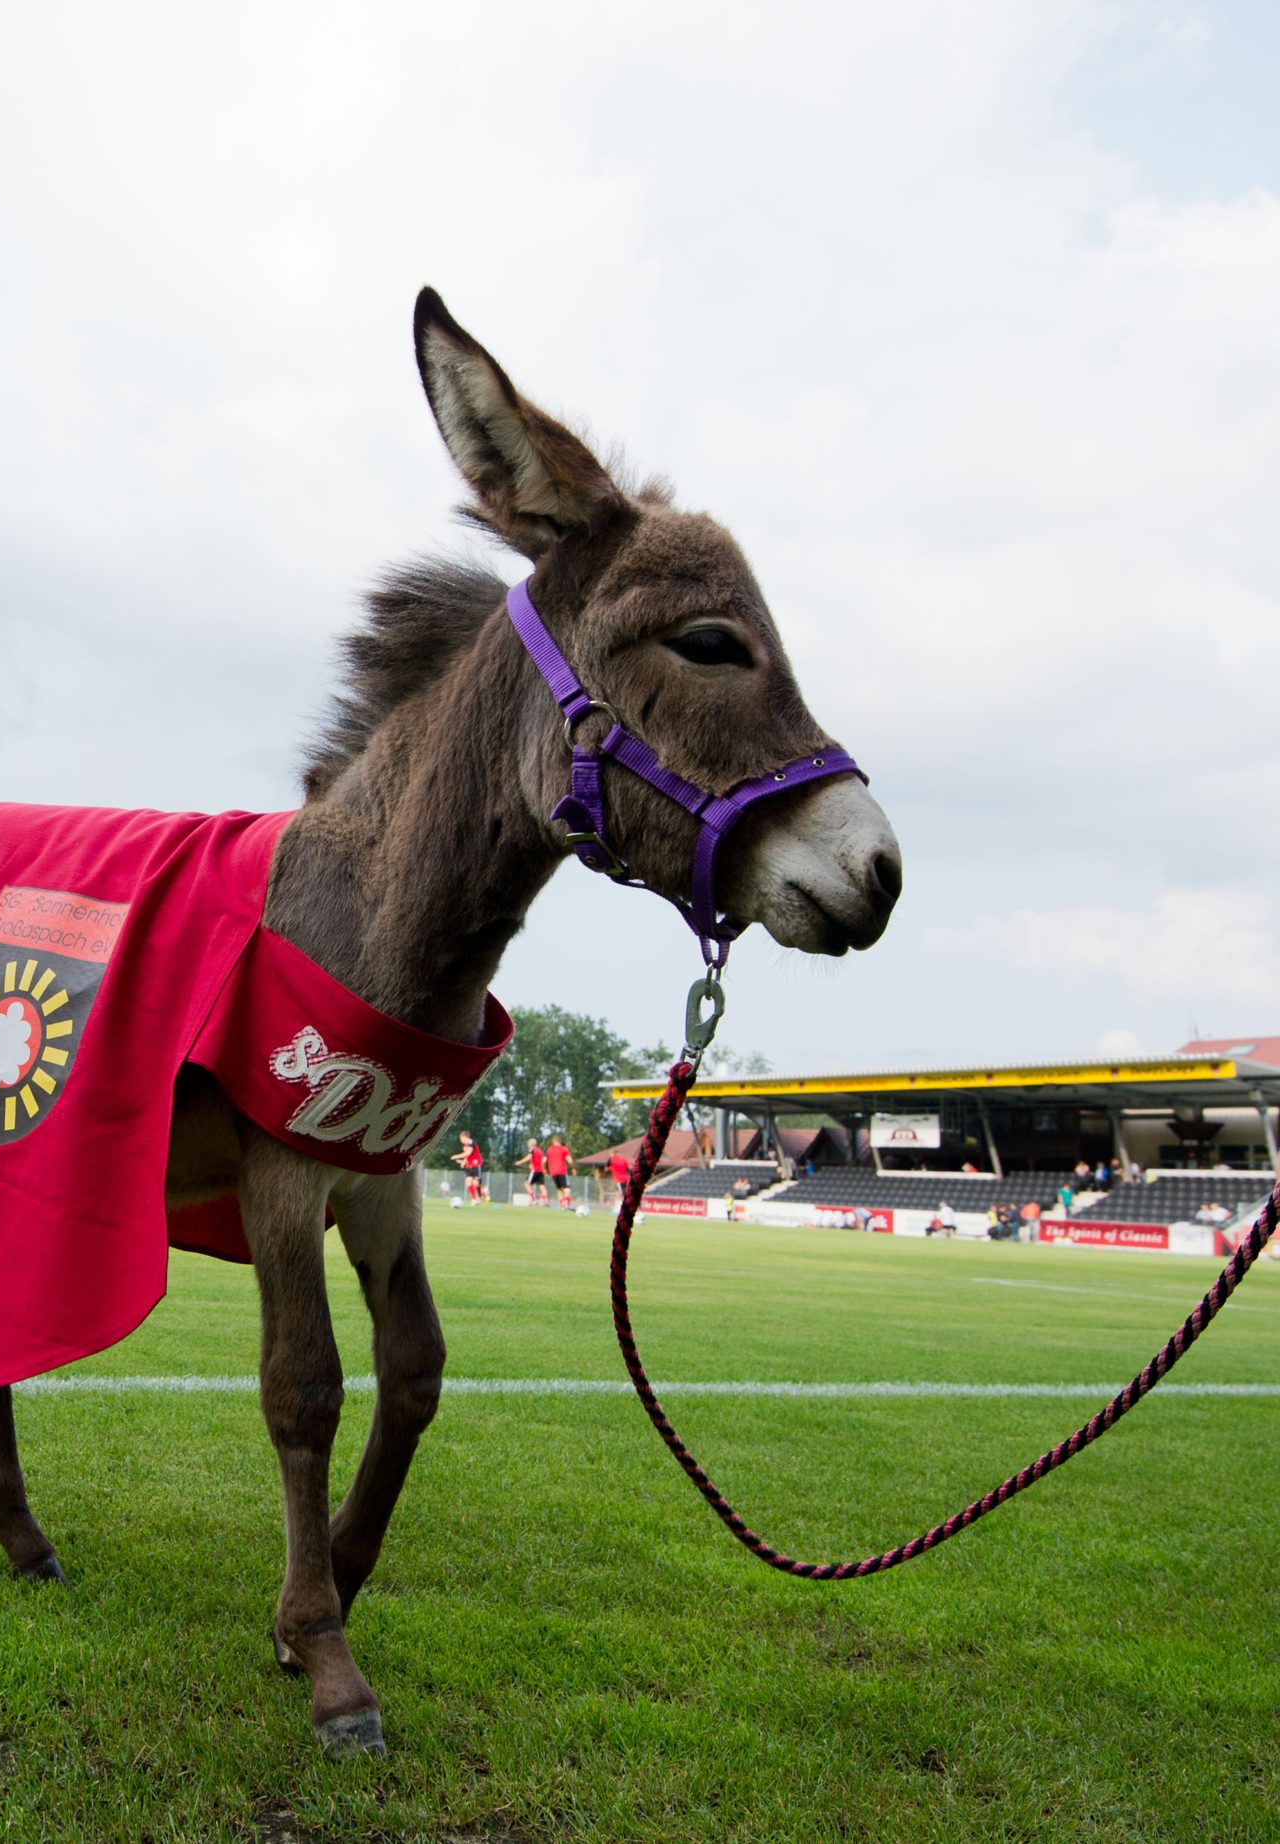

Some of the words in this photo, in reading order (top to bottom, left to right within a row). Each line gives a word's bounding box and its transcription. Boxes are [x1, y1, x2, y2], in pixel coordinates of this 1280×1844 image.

[0, 892, 23, 909] SG
[1046, 1225, 1065, 1236] The
[1068, 1226, 1101, 1241] Spirit
[1104, 1229, 1117, 1243] of
[1120, 1230, 1163, 1243] Classic
